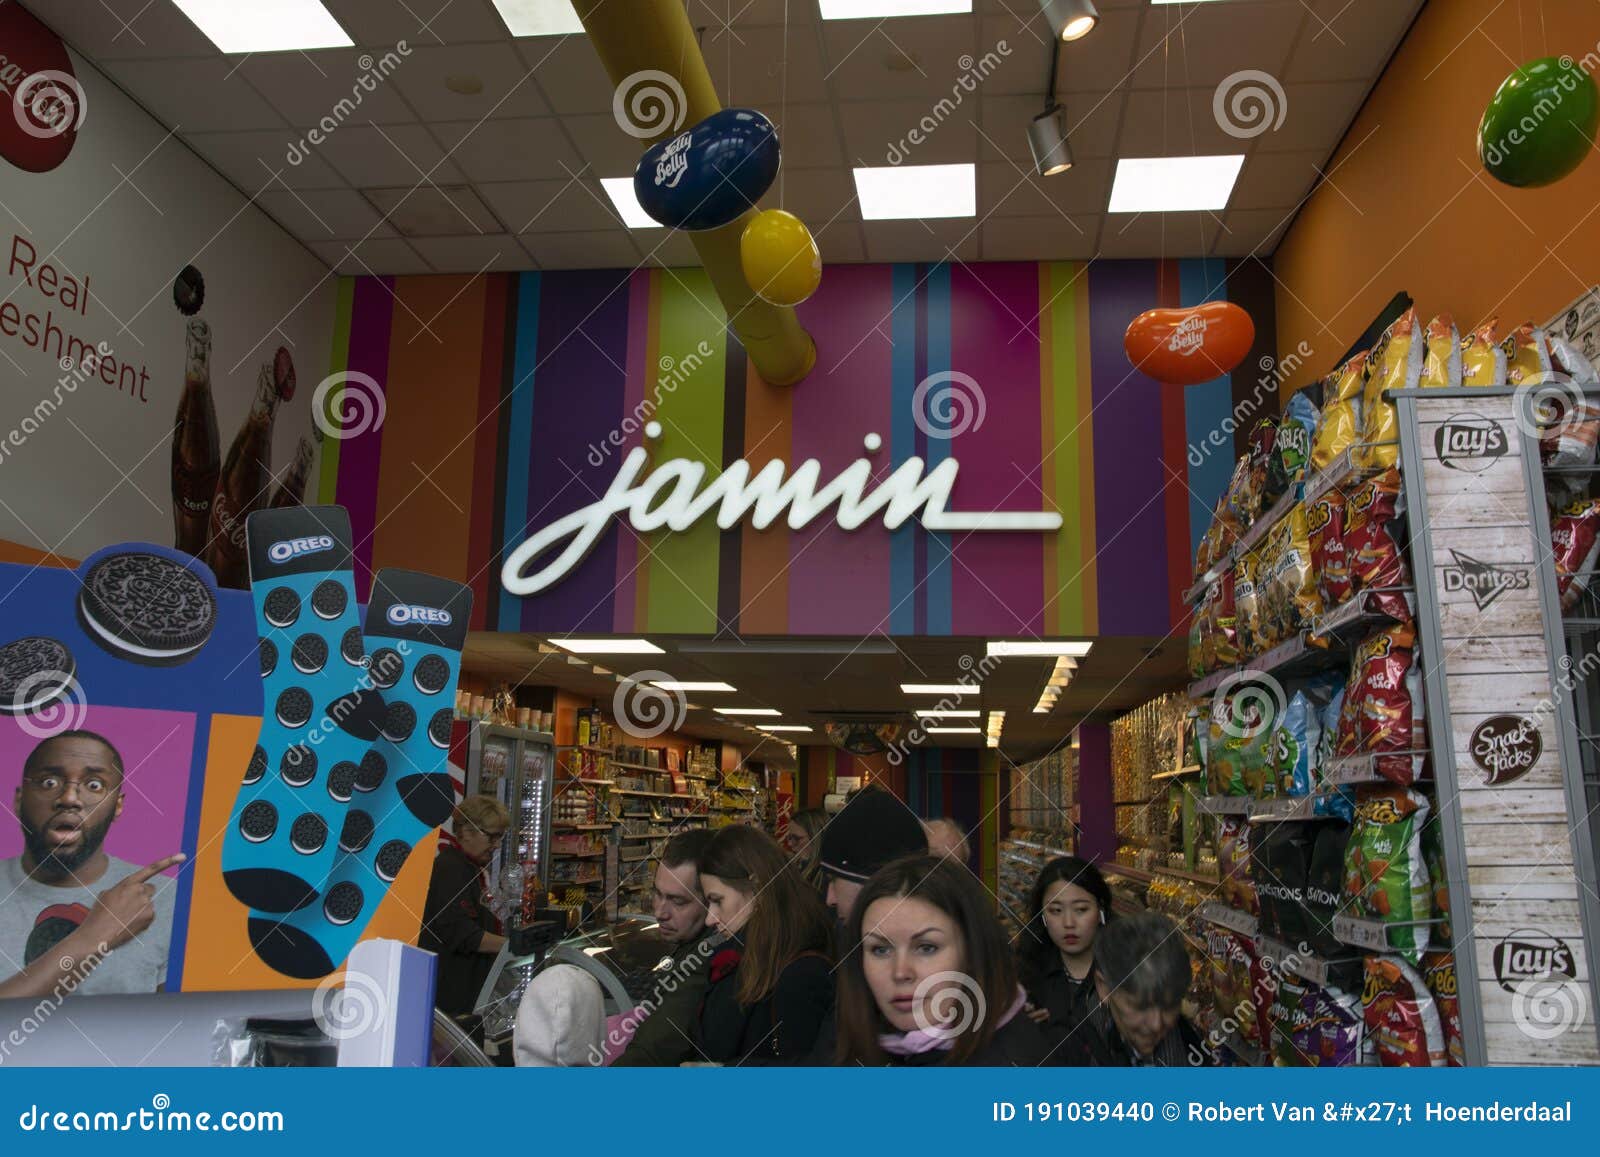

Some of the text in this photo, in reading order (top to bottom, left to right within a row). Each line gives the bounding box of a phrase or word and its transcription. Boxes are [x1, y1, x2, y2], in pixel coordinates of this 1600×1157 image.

[656, 130, 693, 162] Jelly
[654, 152, 688, 188] Belly
[9, 234, 90, 316] Real
[1441, 424, 1502, 457] Lay's
[500, 420, 1064, 596] jamin
[268, 535, 333, 563] OREO
[1443, 567, 1530, 593] Doritos
[388, 604, 451, 625] OREO
[1475, 723, 1533, 756] Snack
[1482, 746, 1533, 785] Jacks
[1501, 942, 1568, 980] Lay's
